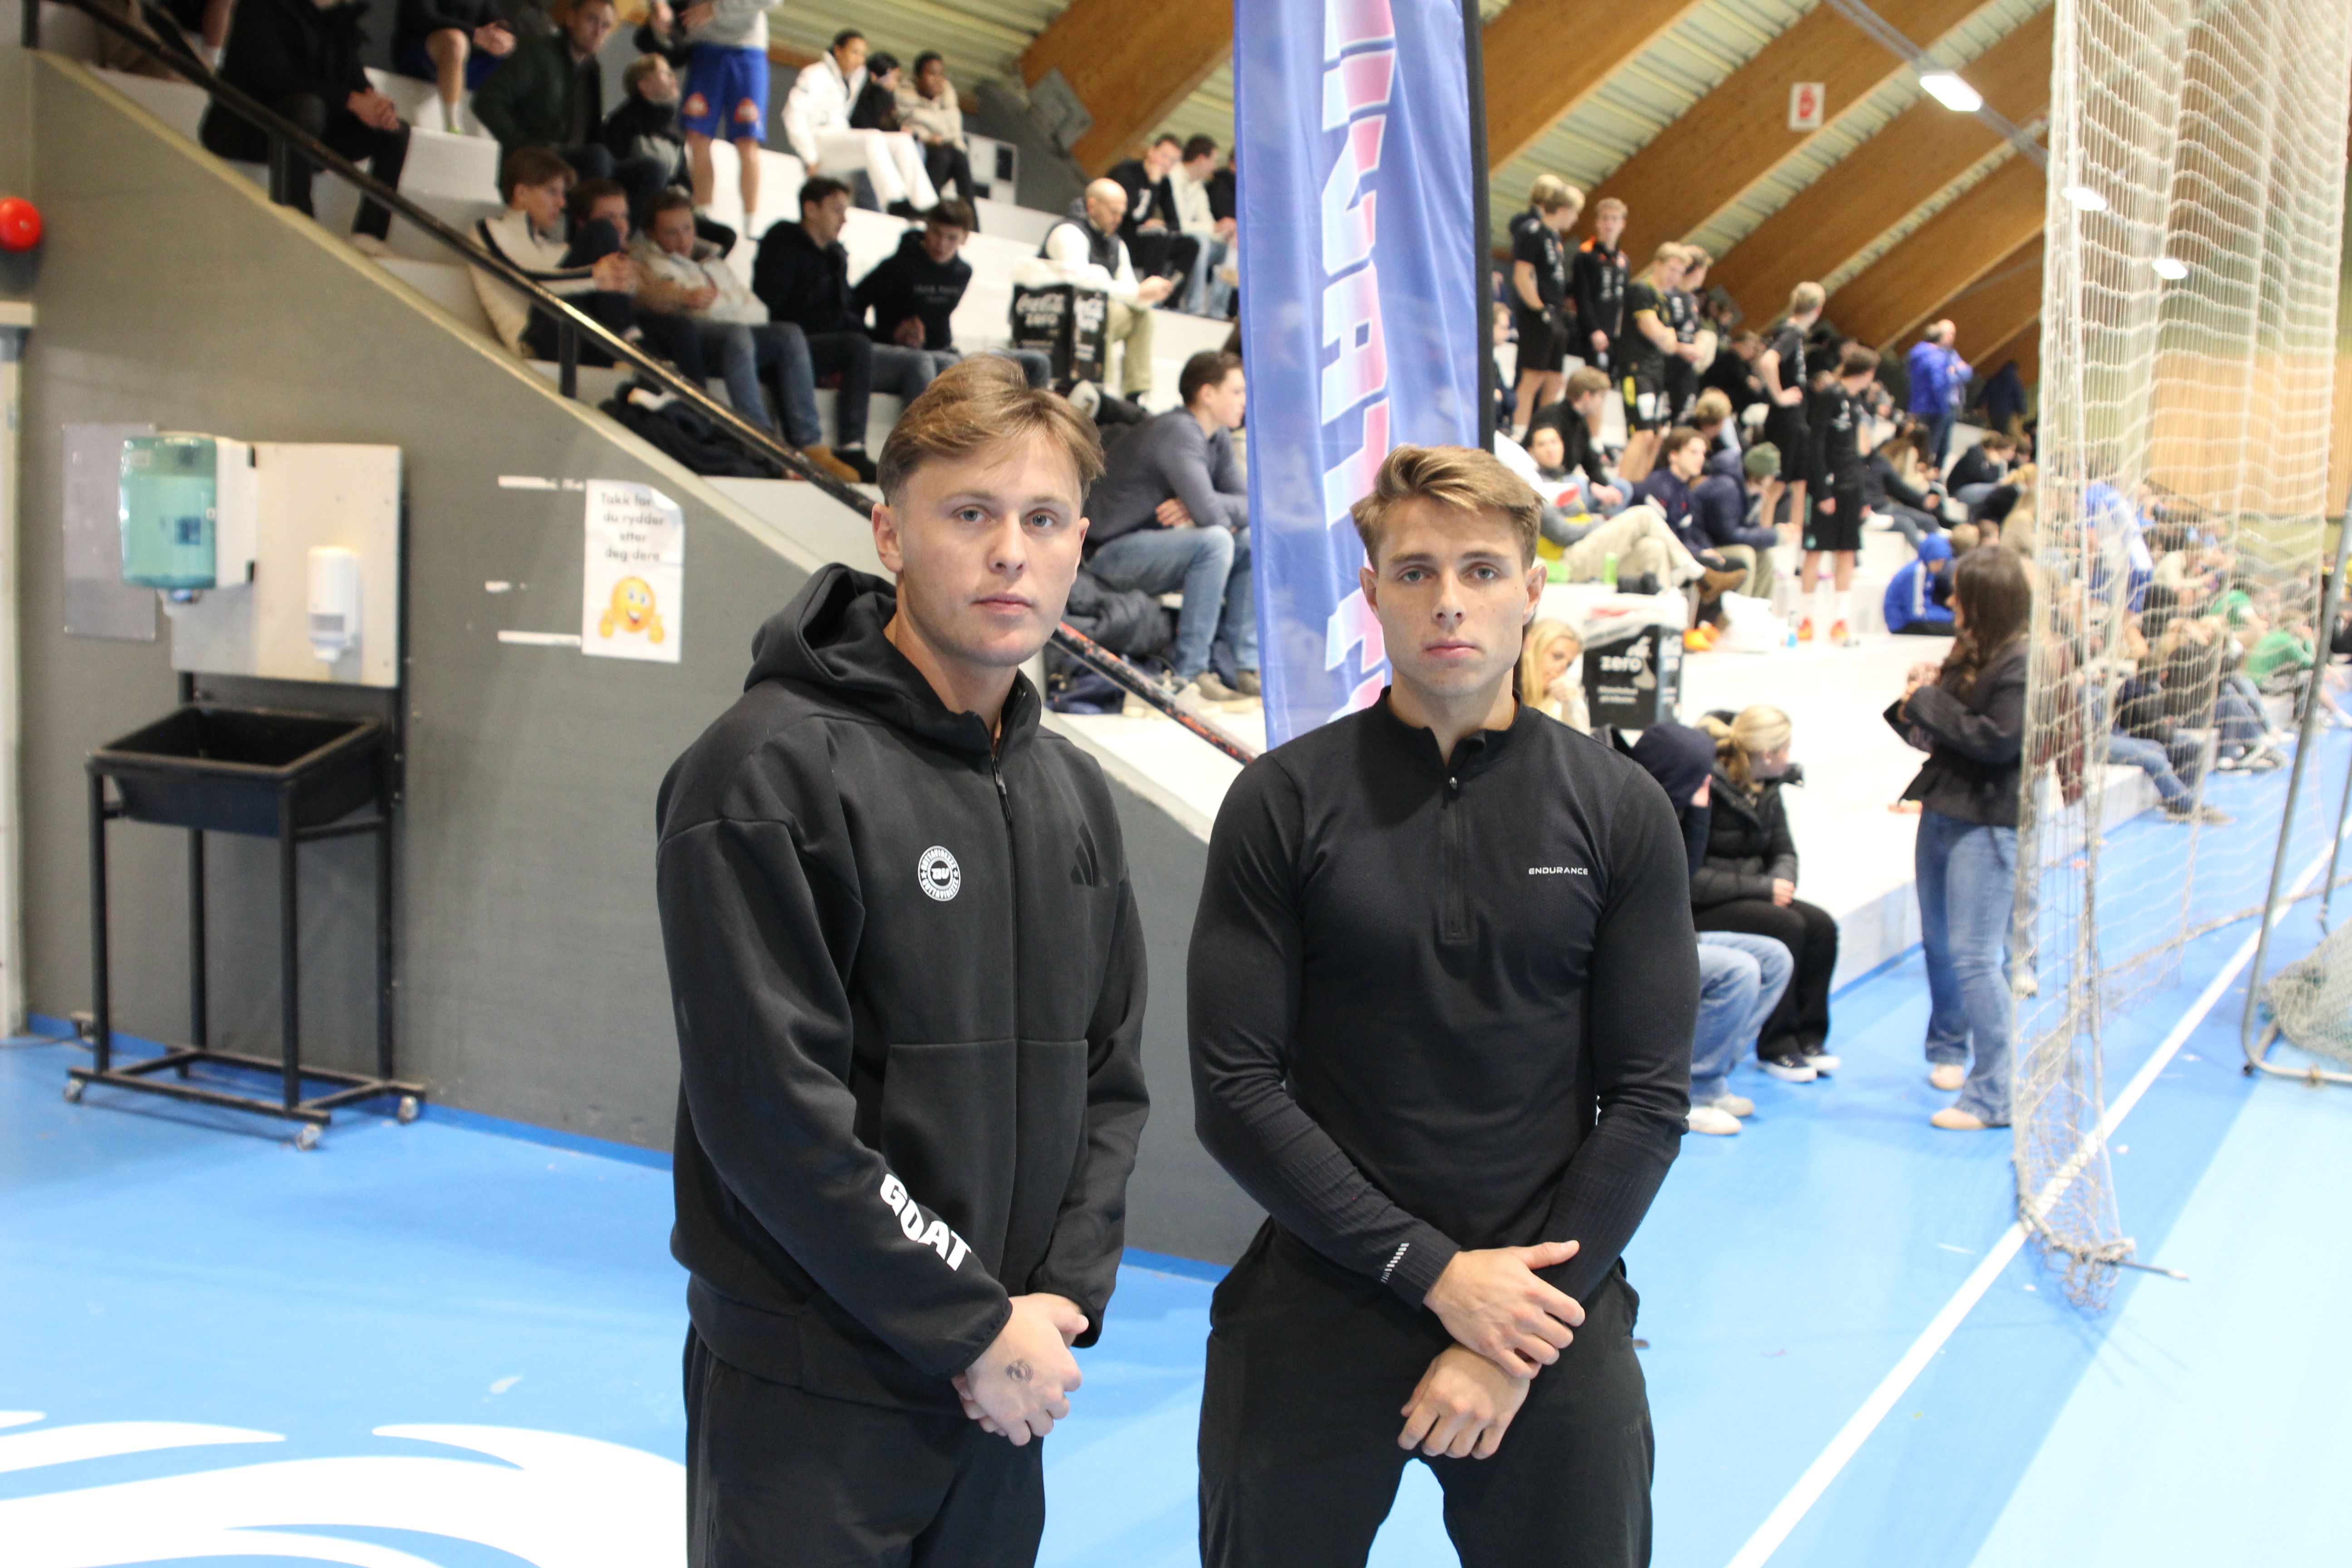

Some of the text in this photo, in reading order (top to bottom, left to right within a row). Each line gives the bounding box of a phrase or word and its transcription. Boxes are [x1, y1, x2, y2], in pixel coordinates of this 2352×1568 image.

[601, 492, 652, 505] Takk for
[603, 510, 664, 527] du rydder
[605, 546, 628, 562] deg
[1599, 655, 1642, 673] zero
[1528, 867, 1588, 875] ENDURANCE
[880, 1173, 972, 1271] GOAT
